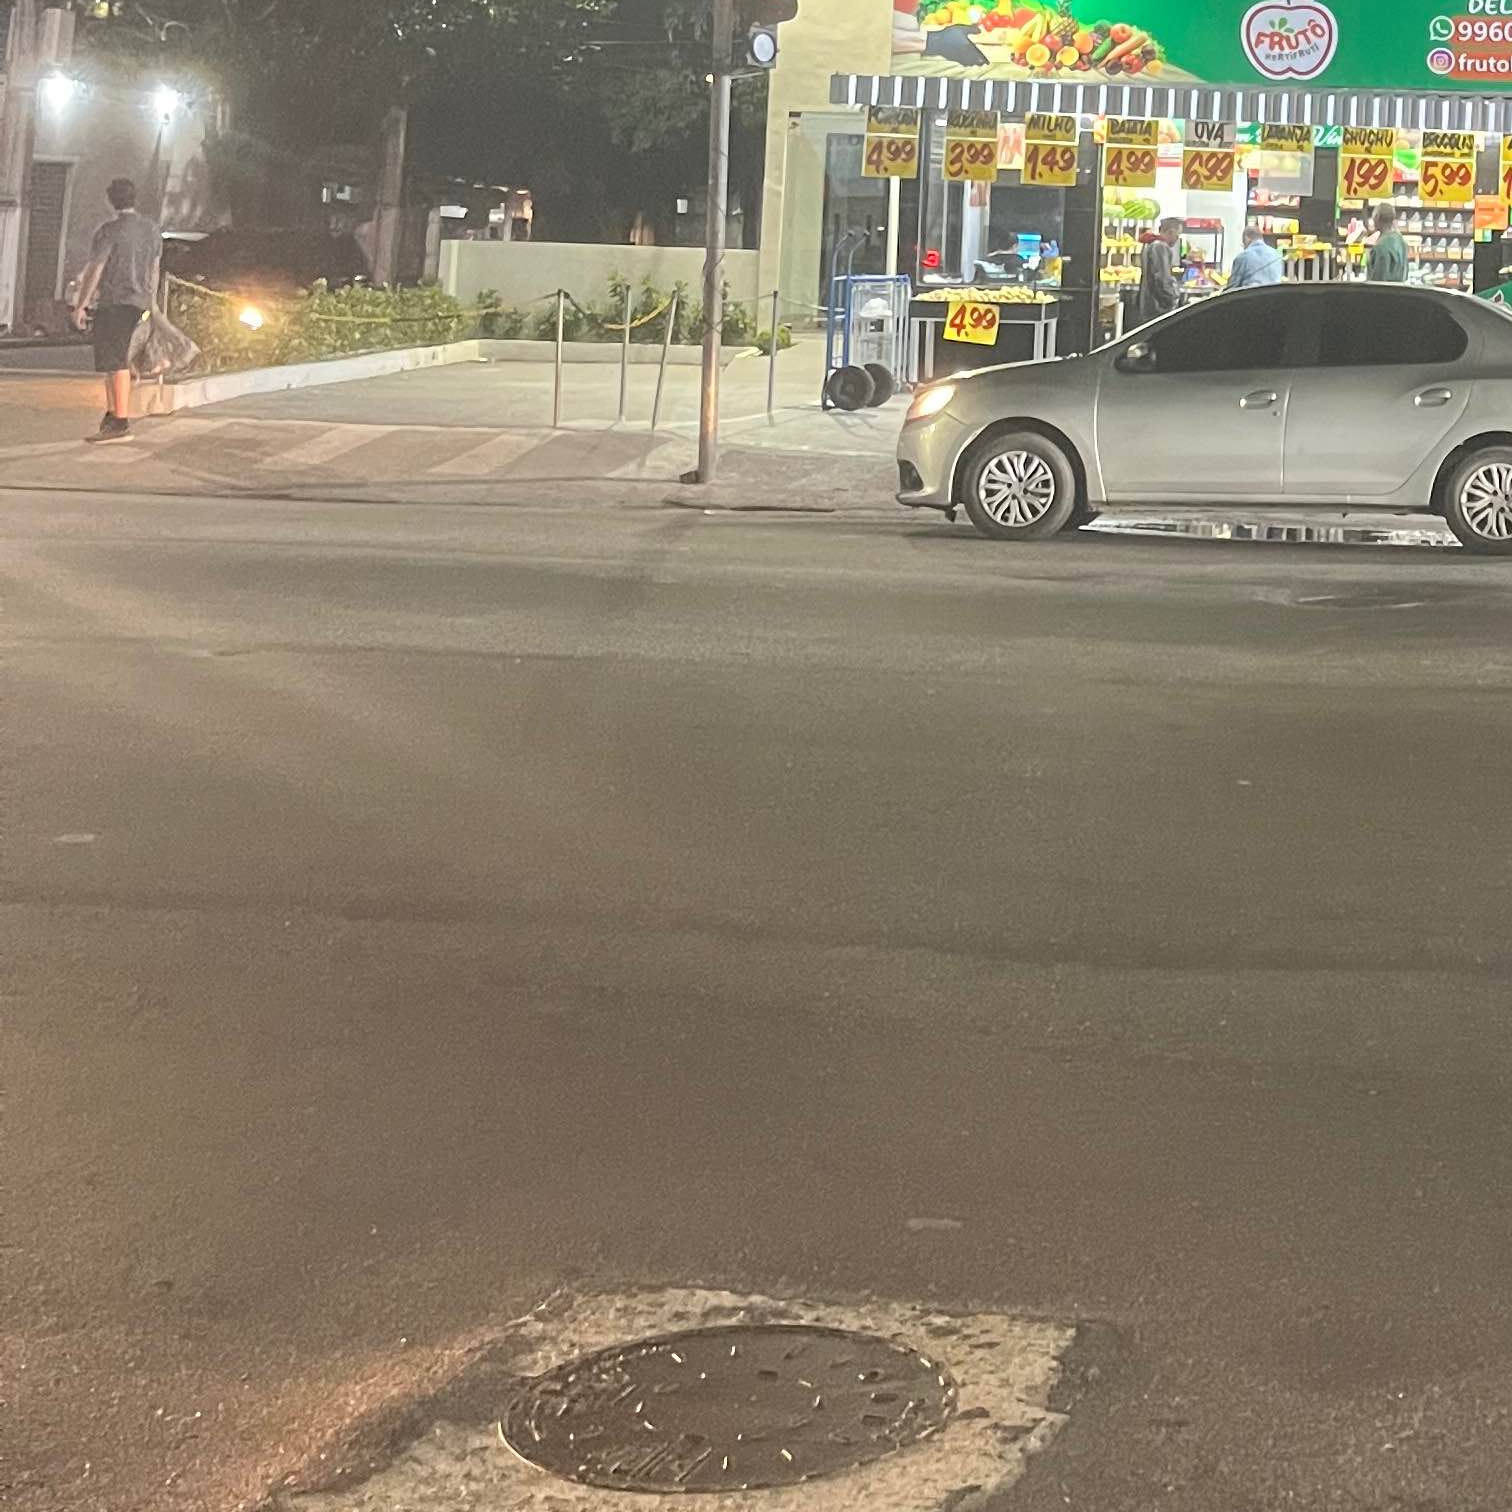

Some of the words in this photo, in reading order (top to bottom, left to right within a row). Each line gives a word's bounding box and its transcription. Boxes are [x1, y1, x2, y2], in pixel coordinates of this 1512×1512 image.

[1028, 115, 1075, 134] MILHO
[867, 139, 917, 174] 4.99
[947, 142, 996, 178] 3.99
[1026, 145, 1076, 180] 1.49
[1106, 149, 1156, 184] 4.99
[1343, 158, 1389, 196] 1.99
[1422, 161, 1472, 197] 5.99
[949, 303, 997, 338] 4.99
